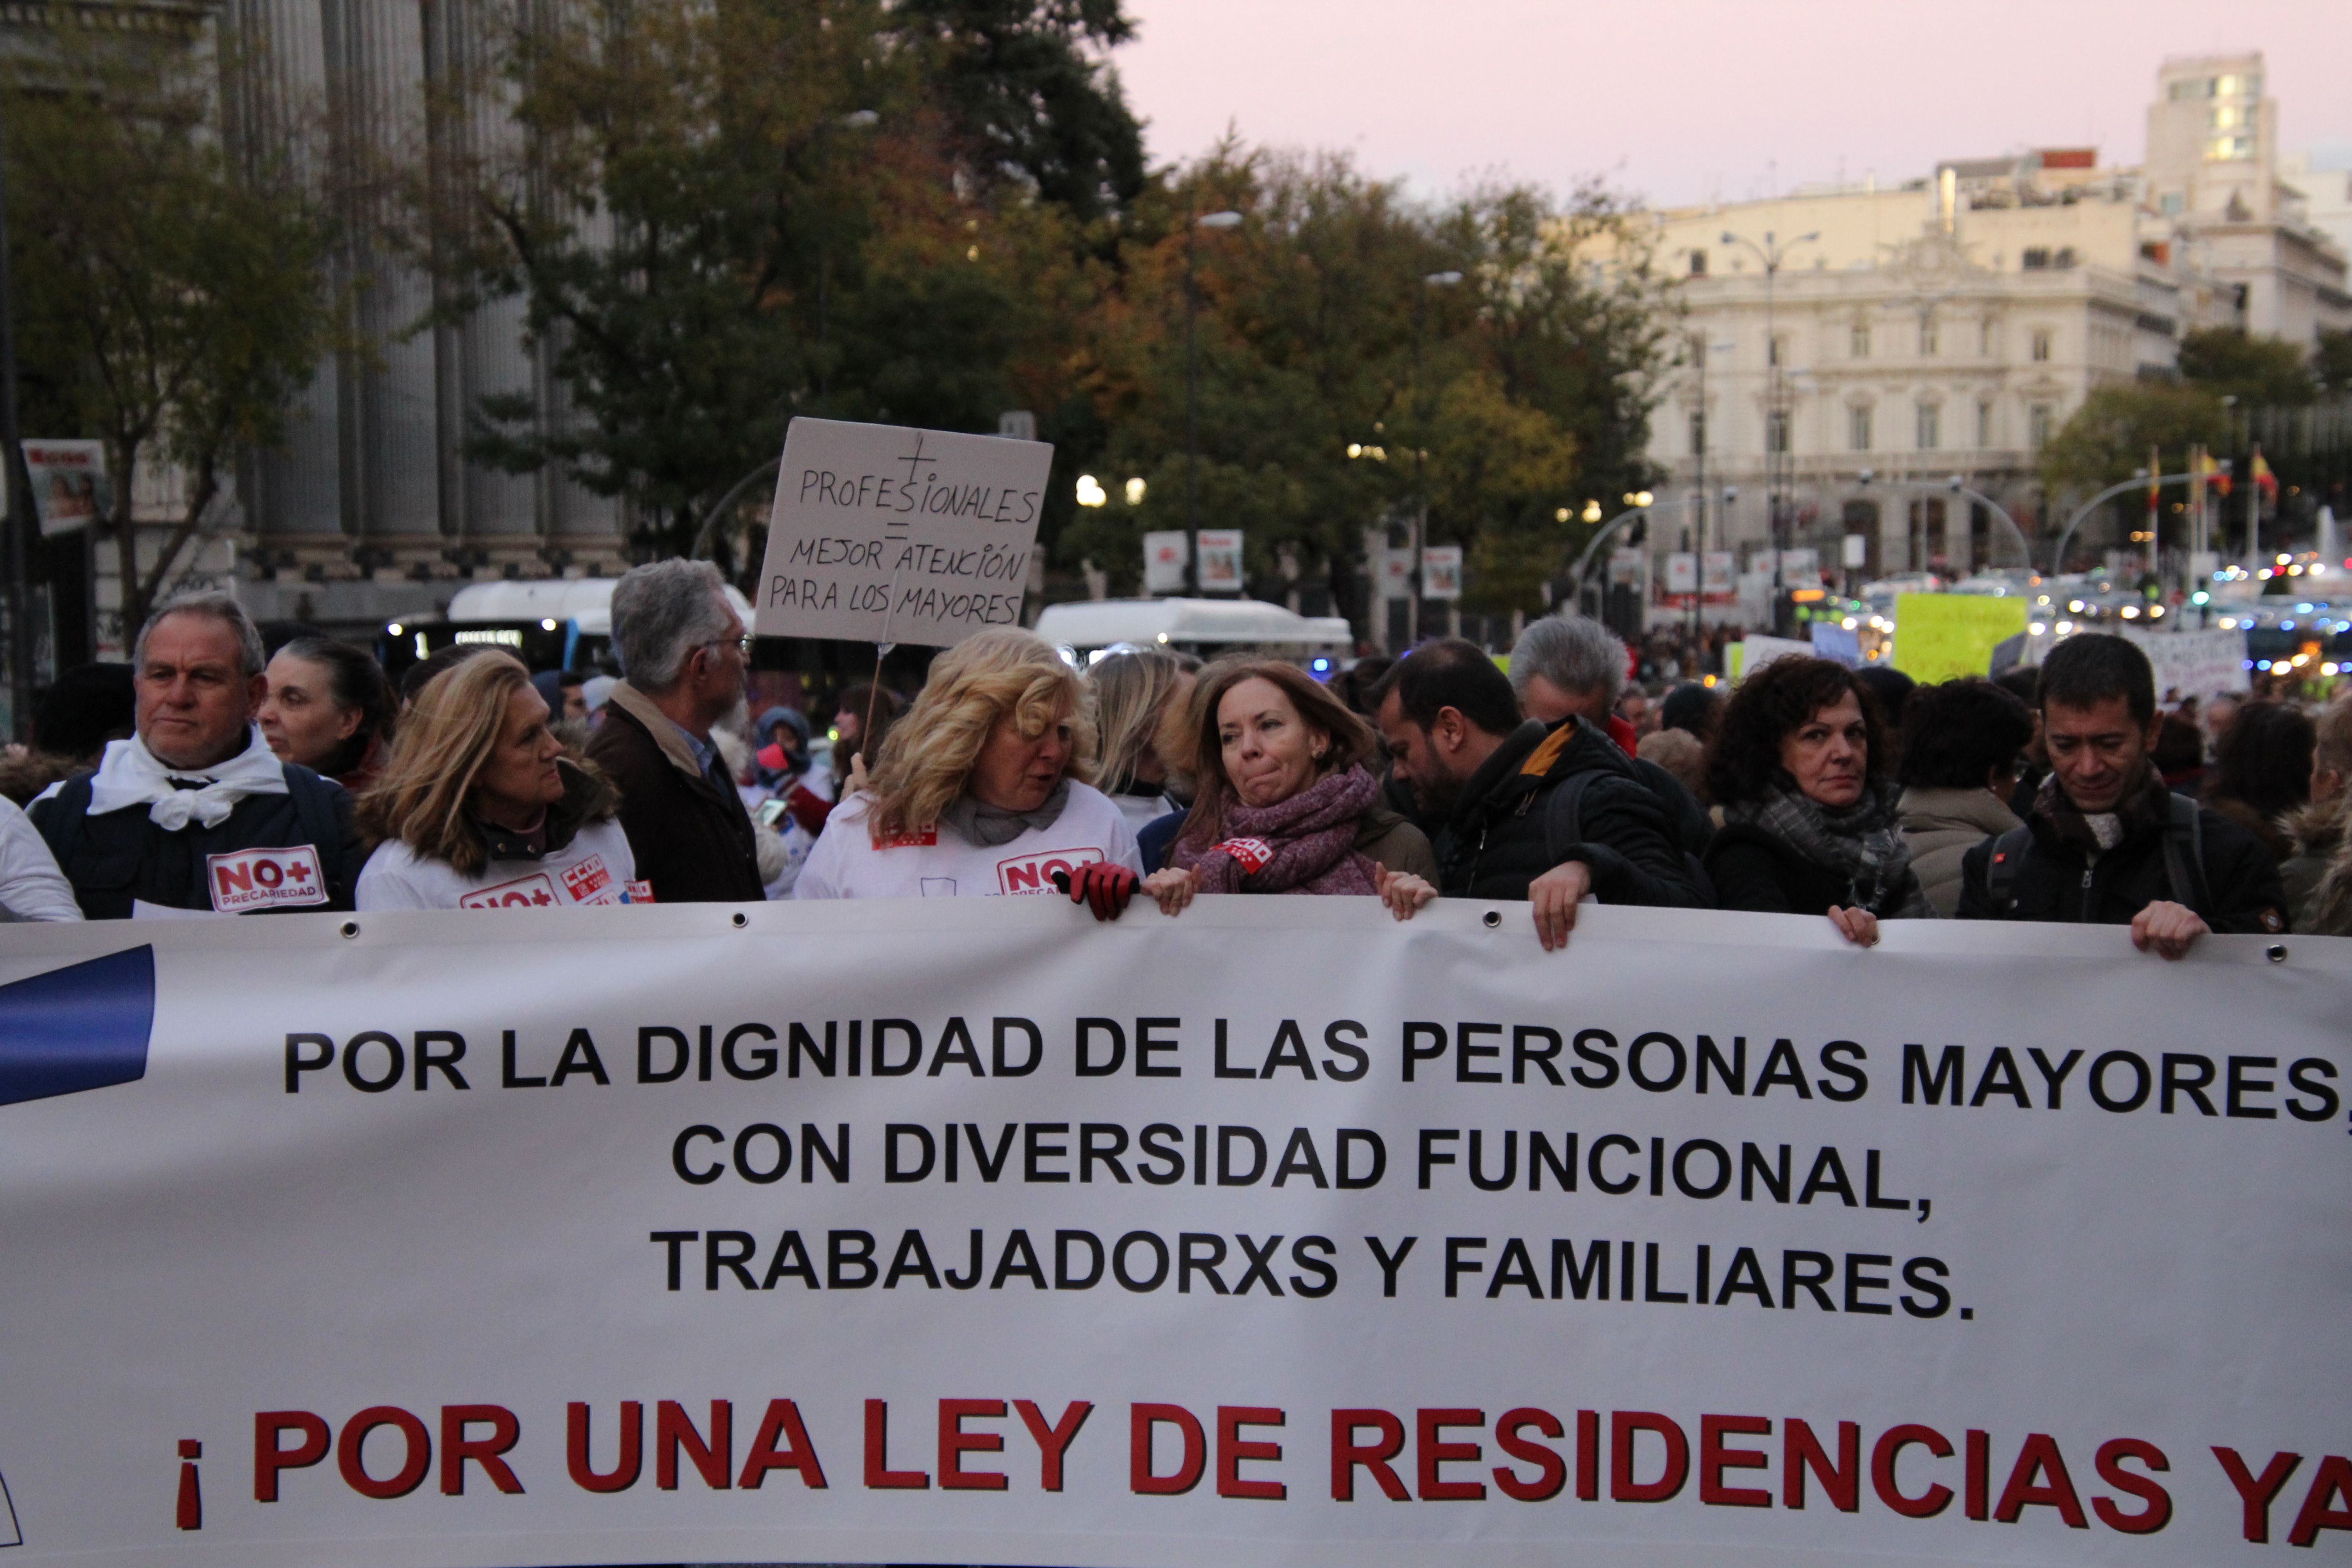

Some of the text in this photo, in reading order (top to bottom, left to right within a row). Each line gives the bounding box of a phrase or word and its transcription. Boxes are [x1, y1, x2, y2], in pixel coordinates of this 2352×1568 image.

[790, 537, 1025, 581] MEJOR ATENCIÓN
[770, 575, 1020, 624] PARA LOS MAYORES
[222, 886, 317, 905] PRECARIEDAD
[561, 853, 604, 888] CCOO
[284, 1030, 471, 1094] POR
[501, 1027, 611, 1089] LA
[637, 1016, 1044, 1084] DIGNIDAD
[1075, 1016, 1182, 1078] DE
[1214, 1018, 1370, 1083] LAS
[1401, 1021, 1869, 1102] PERSONAS
[671, 1122, 1931, 1224] CON DIVERSIDAD FUNCIONAL,
[649, 1228, 1974, 1321] TRABAJADORXS Y FAMILIARES.
[254, 1403, 526, 1504] POR
[566, 1398, 829, 1494] UNA
[864, 1398, 1096, 1493] LEY
[1130, 1401, 1288, 1501] DE
[1330, 1406, 2173, 1535] RESIDENCIAS
[2210, 1446, 2352, 1548] YA
